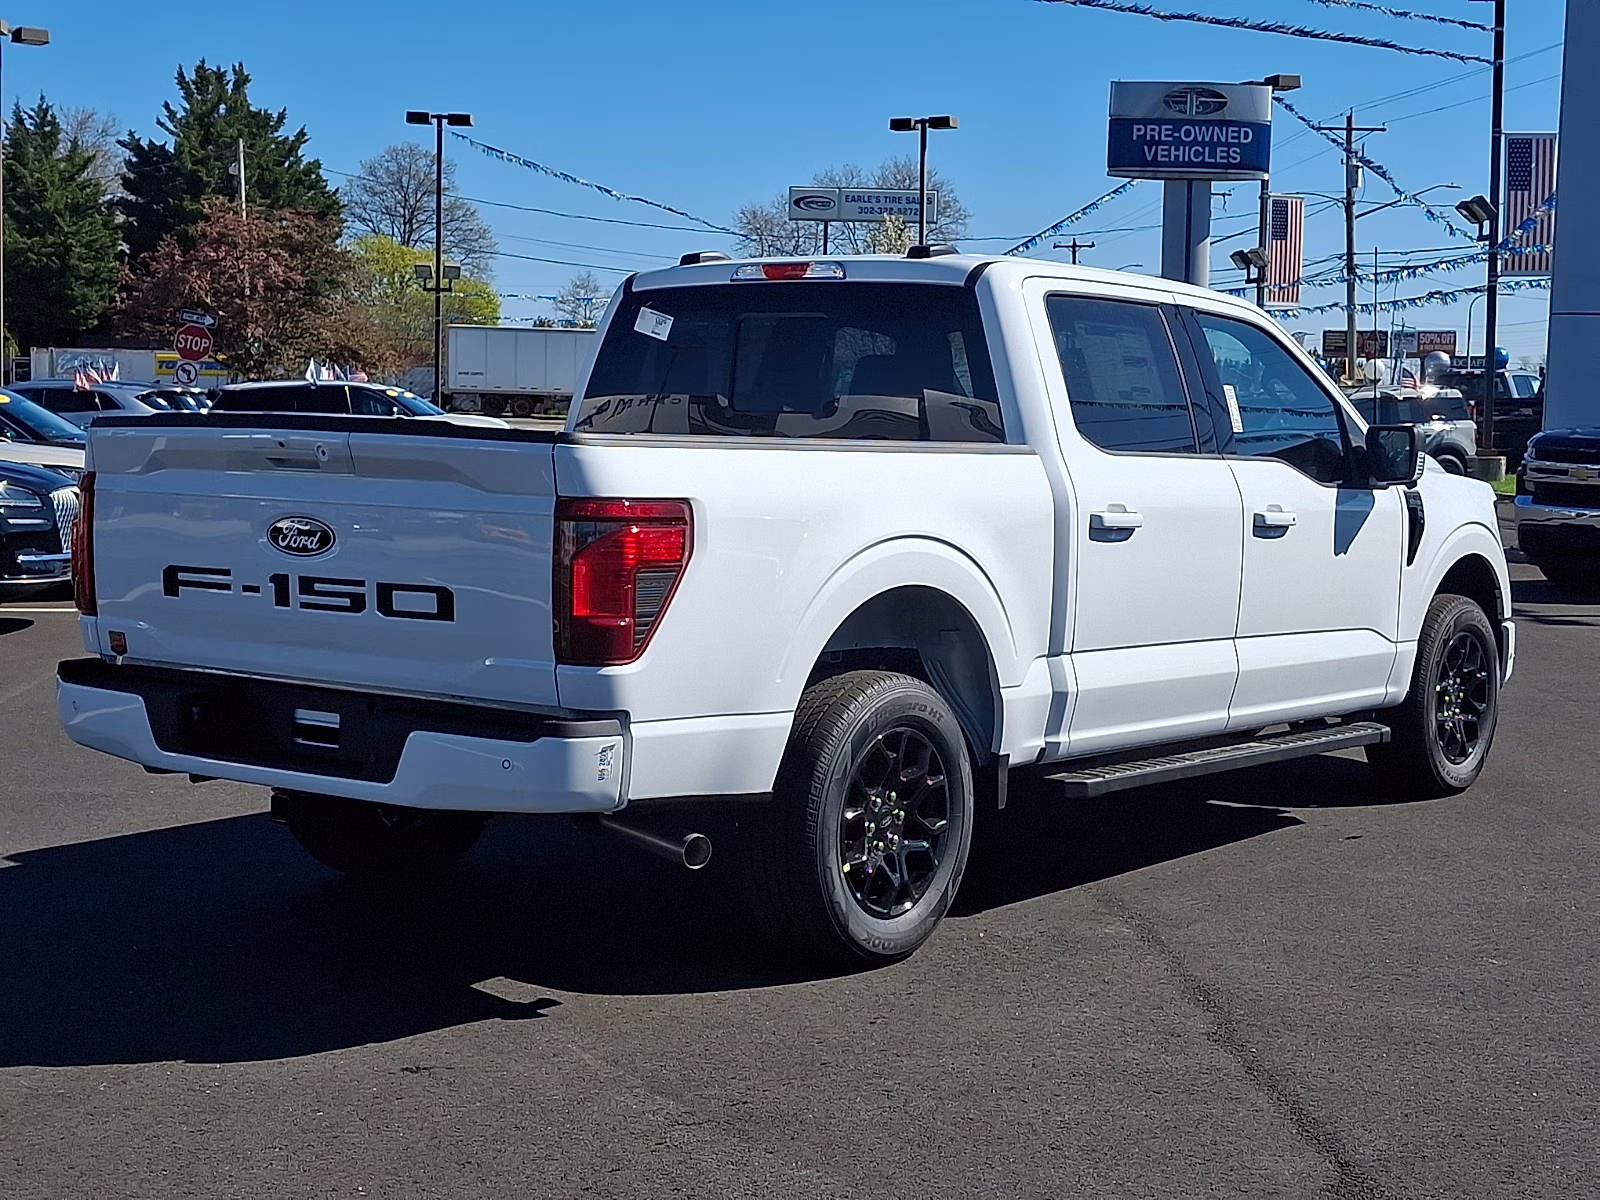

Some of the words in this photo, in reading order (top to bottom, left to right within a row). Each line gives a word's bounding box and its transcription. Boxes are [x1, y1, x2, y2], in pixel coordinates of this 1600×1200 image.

[1132, 124, 1253, 143] PRE-OWNED
[1144, 145, 1241, 164] VEHICLES
[845, 194, 881, 204] EARLE'S
[883, 195, 903, 205] TIRE
[905, 196, 932, 205] SALS
[177, 334, 209, 352] STOP
[1419, 333, 1441, 344] 50%
[1441, 333, 1456, 344] OFF
[278, 520, 321, 550] Ford
[162, 564, 456, 623] F-150
